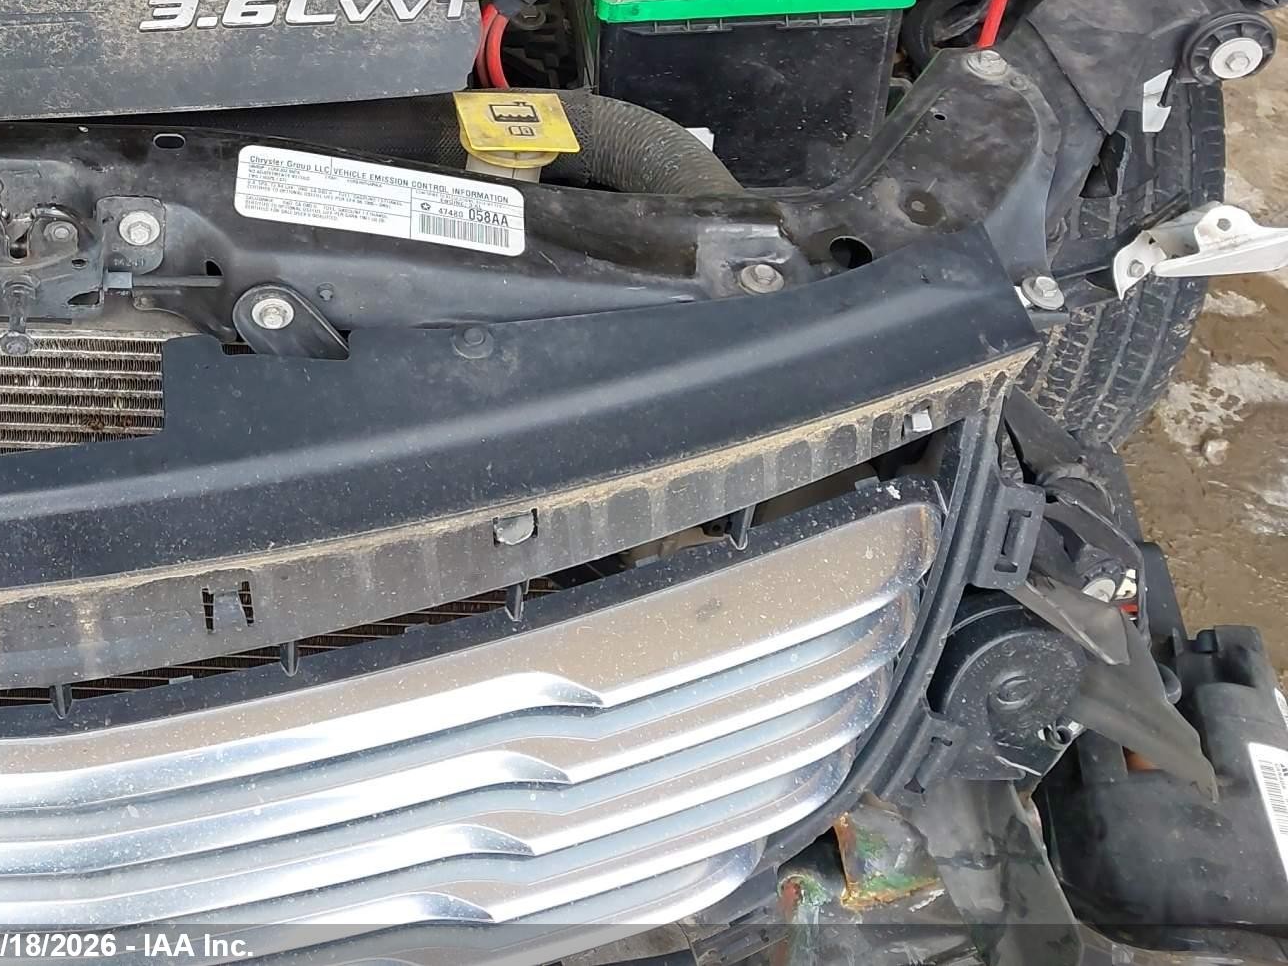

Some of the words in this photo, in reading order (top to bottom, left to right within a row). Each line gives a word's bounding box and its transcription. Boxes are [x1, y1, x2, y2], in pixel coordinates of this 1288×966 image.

[249, 155, 284, 168] Chrysler
[287, 160, 312, 172] Group
[314, 165, 330, 174] LLC
[333, 168, 367, 180] VEHICLE
[369, 173, 409, 186] EMISSION
[411, 180, 448, 193] CONTROL
[452, 186, 509, 203] INFORMATION
[438, 208, 464, 217] 47480
